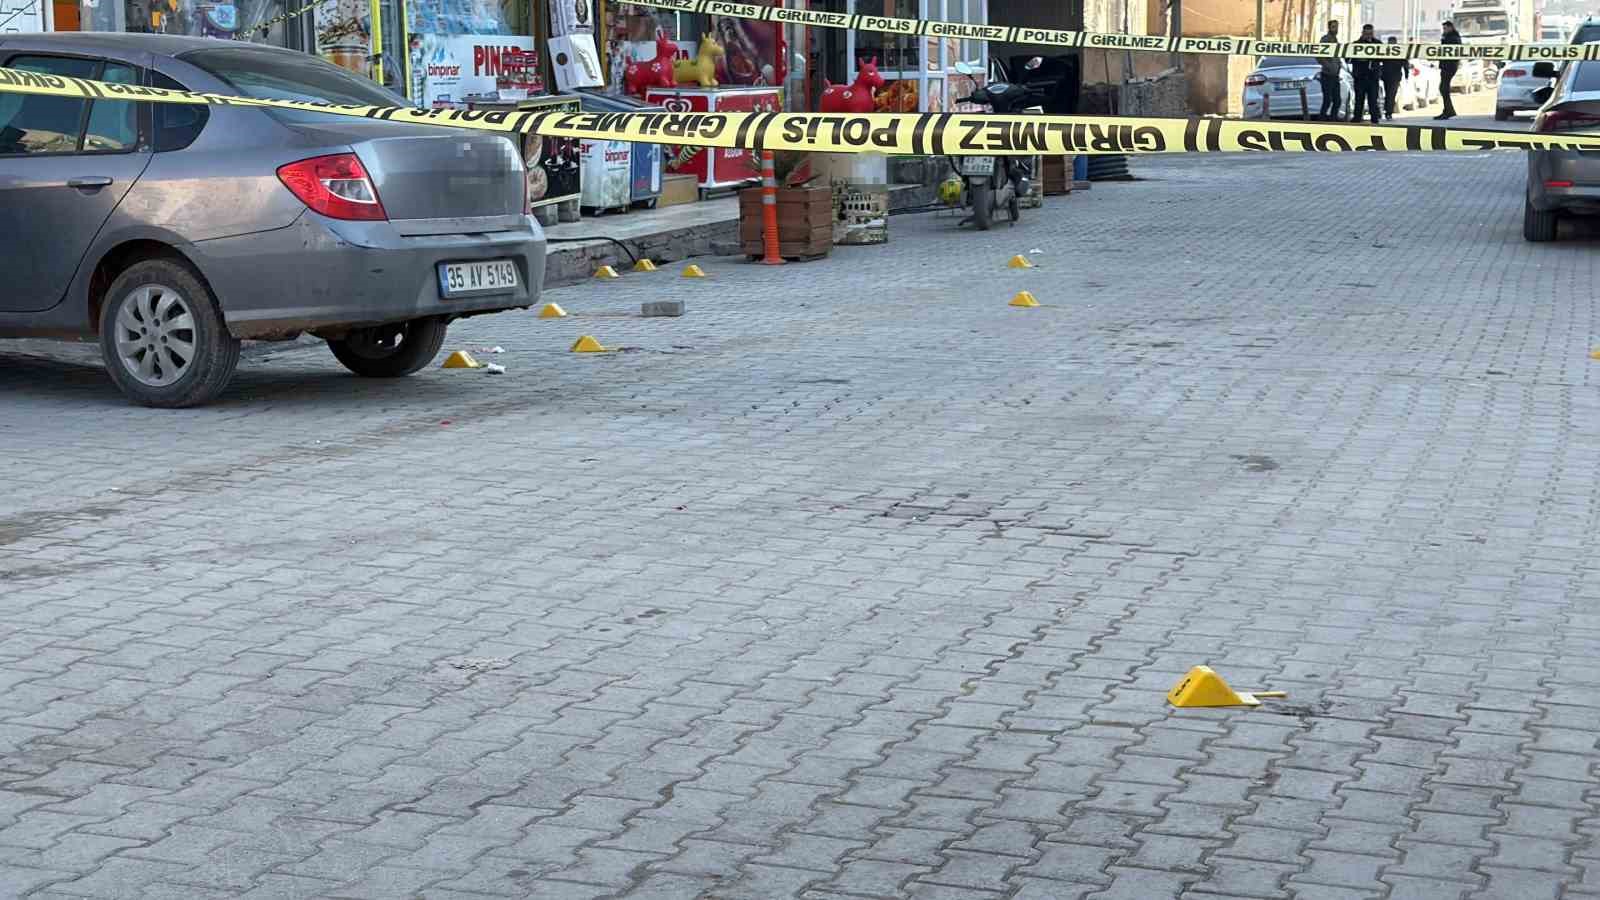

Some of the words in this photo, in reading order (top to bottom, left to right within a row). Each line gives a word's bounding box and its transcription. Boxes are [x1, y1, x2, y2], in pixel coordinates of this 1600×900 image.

[448, 267, 465, 288] 35
[470, 266, 482, 287] AV
[487, 264, 514, 285] 5149
